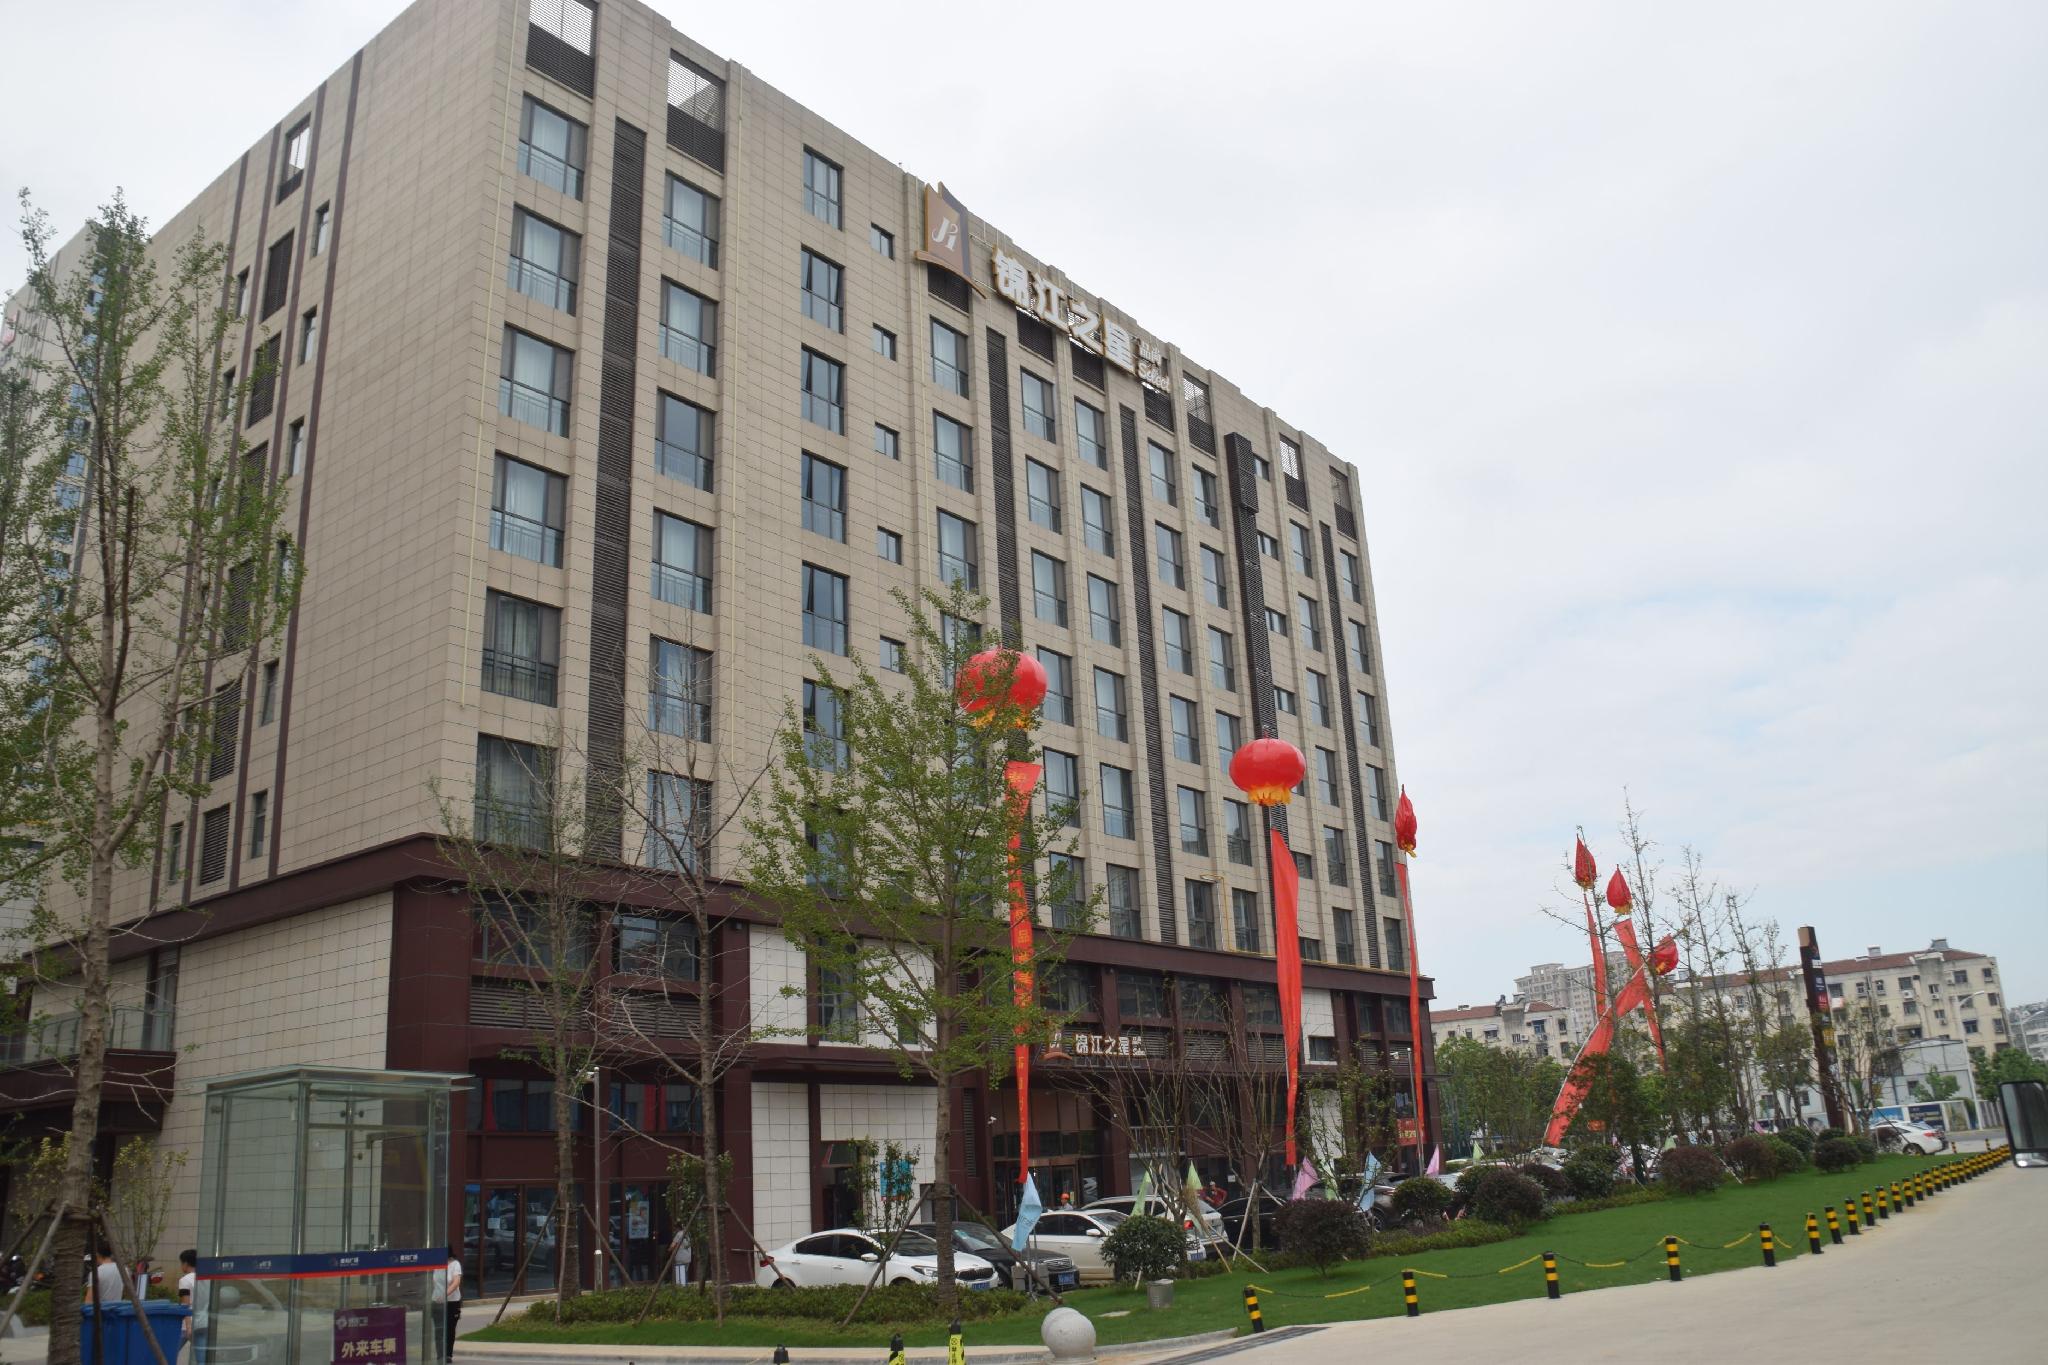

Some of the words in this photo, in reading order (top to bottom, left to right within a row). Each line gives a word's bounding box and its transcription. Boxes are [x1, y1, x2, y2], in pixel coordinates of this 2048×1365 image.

[995, 248, 1136, 373] 锦江之星
[1138, 362, 1170, 393] Select
[1075, 1033, 1130, 1055] 锦江之星
[341, 1338, 396, 1358] 外来车辆
